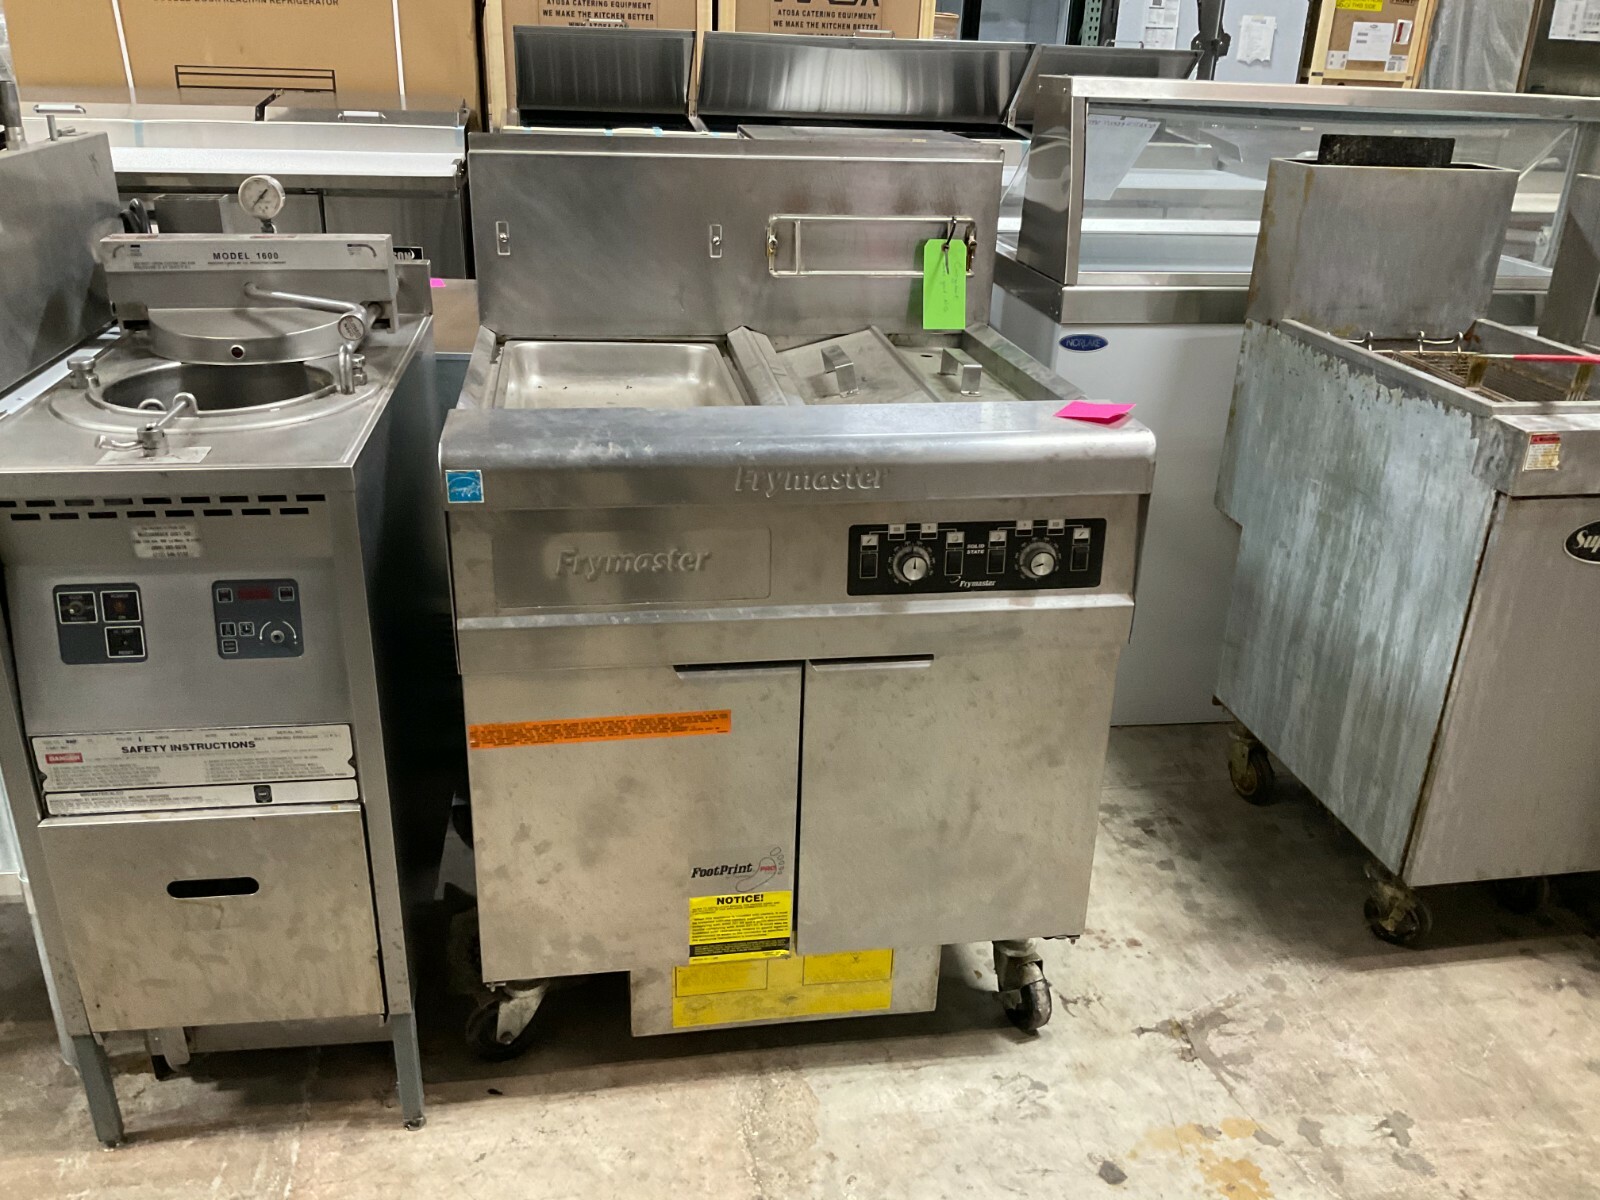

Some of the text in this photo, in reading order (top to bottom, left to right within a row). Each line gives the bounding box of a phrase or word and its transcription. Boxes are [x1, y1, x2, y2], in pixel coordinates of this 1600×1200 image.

[573, 0, 608, 8] CATERING
[610, 1, 652, 10] EQUIPMENT
[543, 9, 654, 21] WE MAKE THE KITCHEN BETTER
[802, 9, 836, 18] CATERING
[838, 11, 876, 20] EQUIPMENT
[773, 20, 878, 31] WE MAKE THE KITCHEN BETTER
[213, 252, 279, 260] MODEL 1600
[734, 466, 883, 497] Frymaster
[555, 547, 712, 582] Frymaster
[960, 580, 996, 588] Frymaster
[121, 740, 256, 754] SAFETY INSTRUCTIONS
[691, 863, 752, 878] FootPrint
[716, 894, 764, 905] NOTICE!
